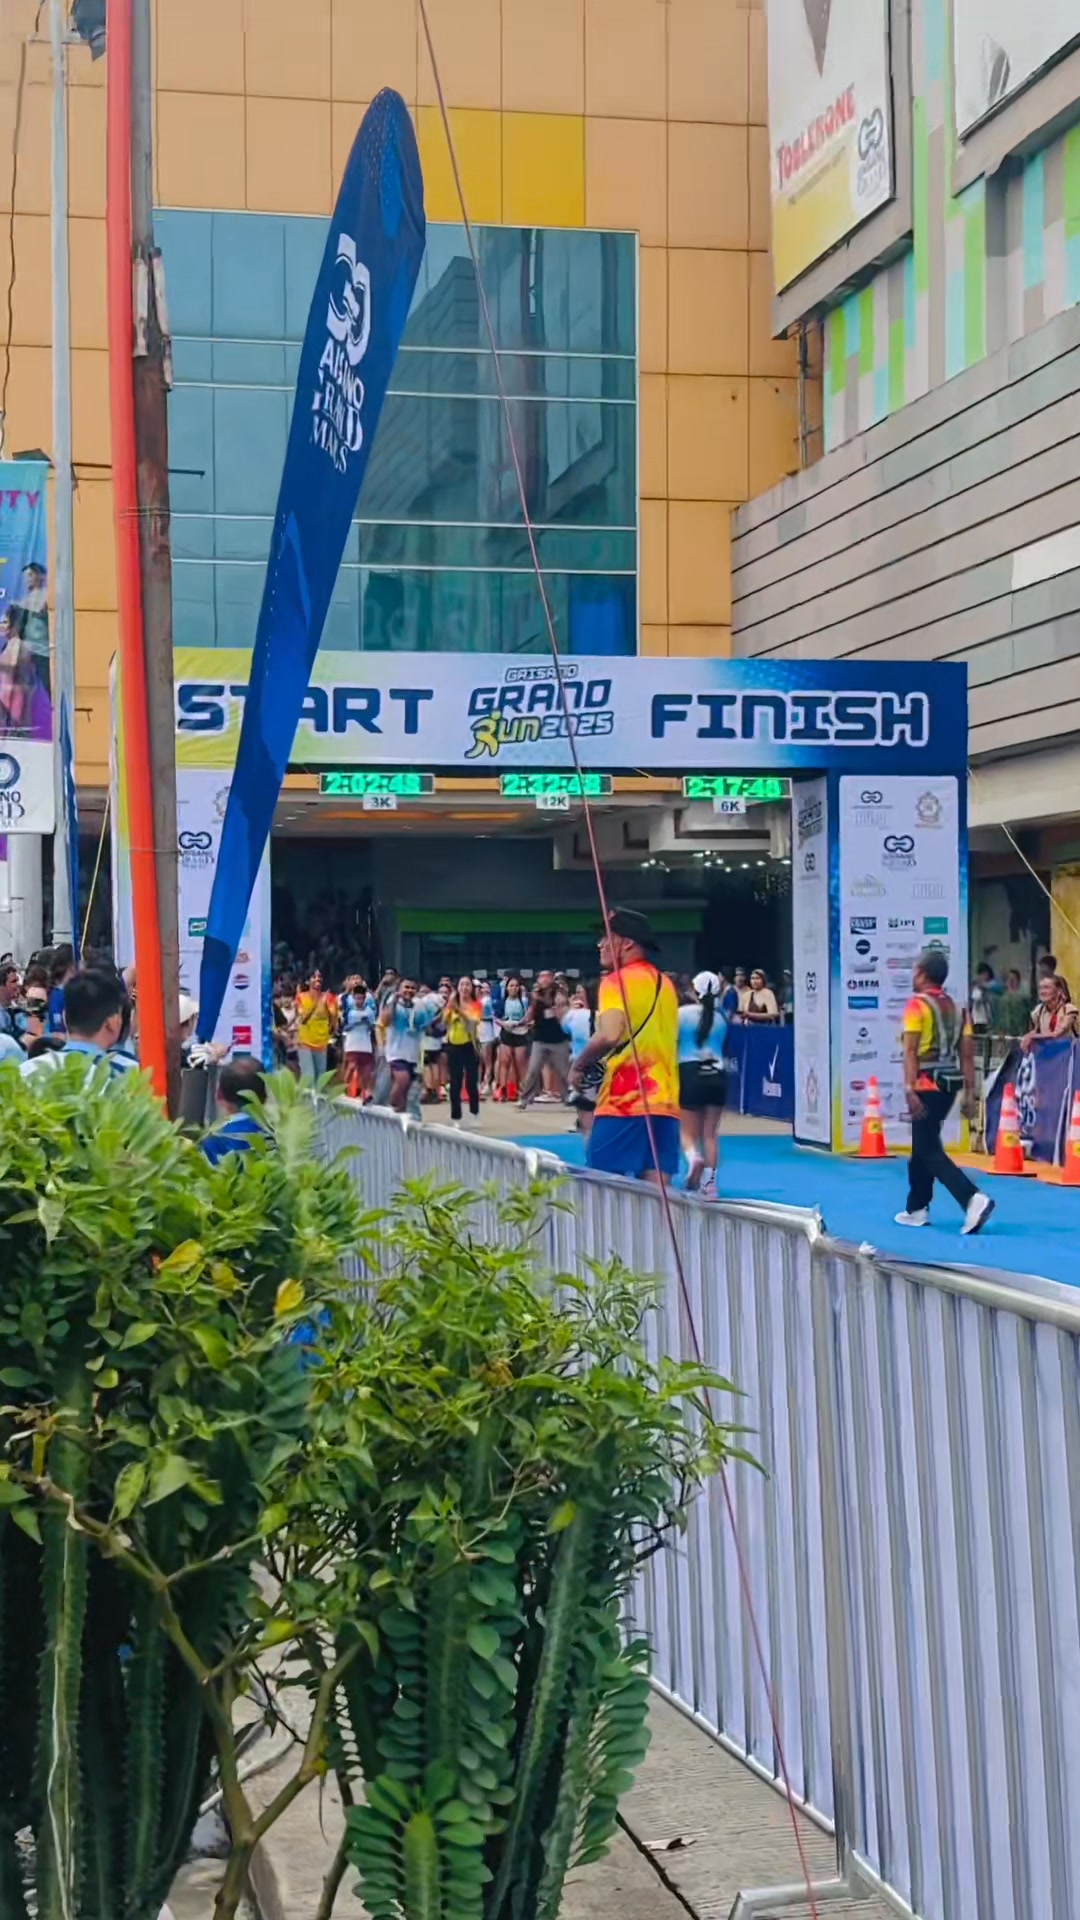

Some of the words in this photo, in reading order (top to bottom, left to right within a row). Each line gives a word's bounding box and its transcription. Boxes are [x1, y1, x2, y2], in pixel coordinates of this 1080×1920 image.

[505, 664, 579, 683] GAISANO
[468, 679, 613, 716] GRAND
[651, 690, 929, 747] FINISH
[370, 797, 391, 808] 3K
[721, 800, 740, 812] 6K
